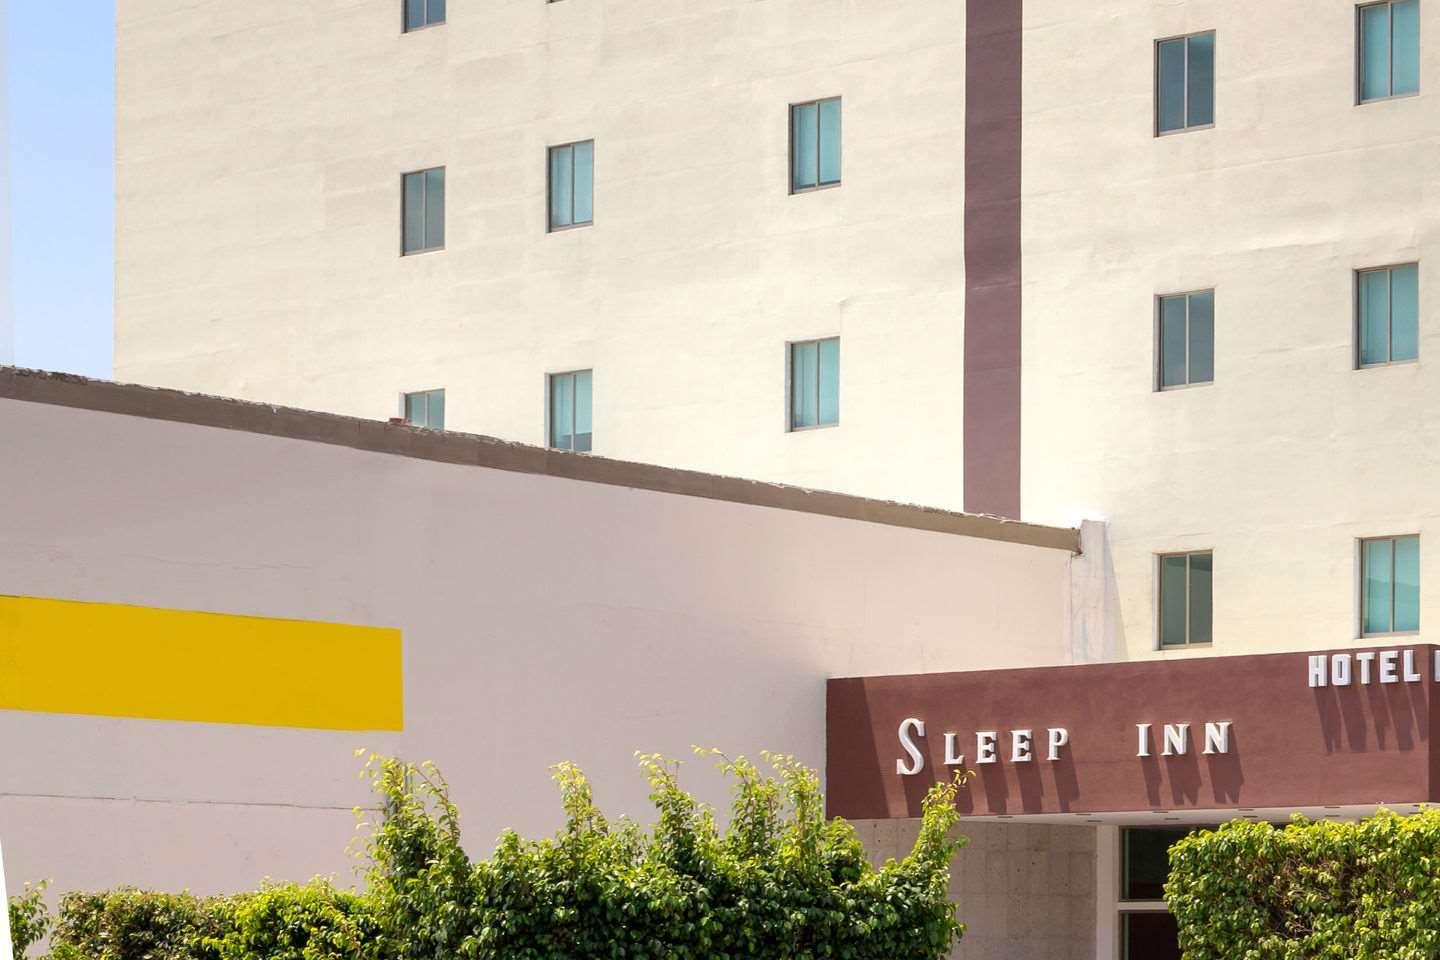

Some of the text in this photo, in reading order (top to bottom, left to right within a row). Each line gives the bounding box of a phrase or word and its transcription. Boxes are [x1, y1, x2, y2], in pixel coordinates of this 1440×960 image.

[1308, 650, 1421, 688] HOTEL
[896, 718, 1232, 776] SLEEP INN
